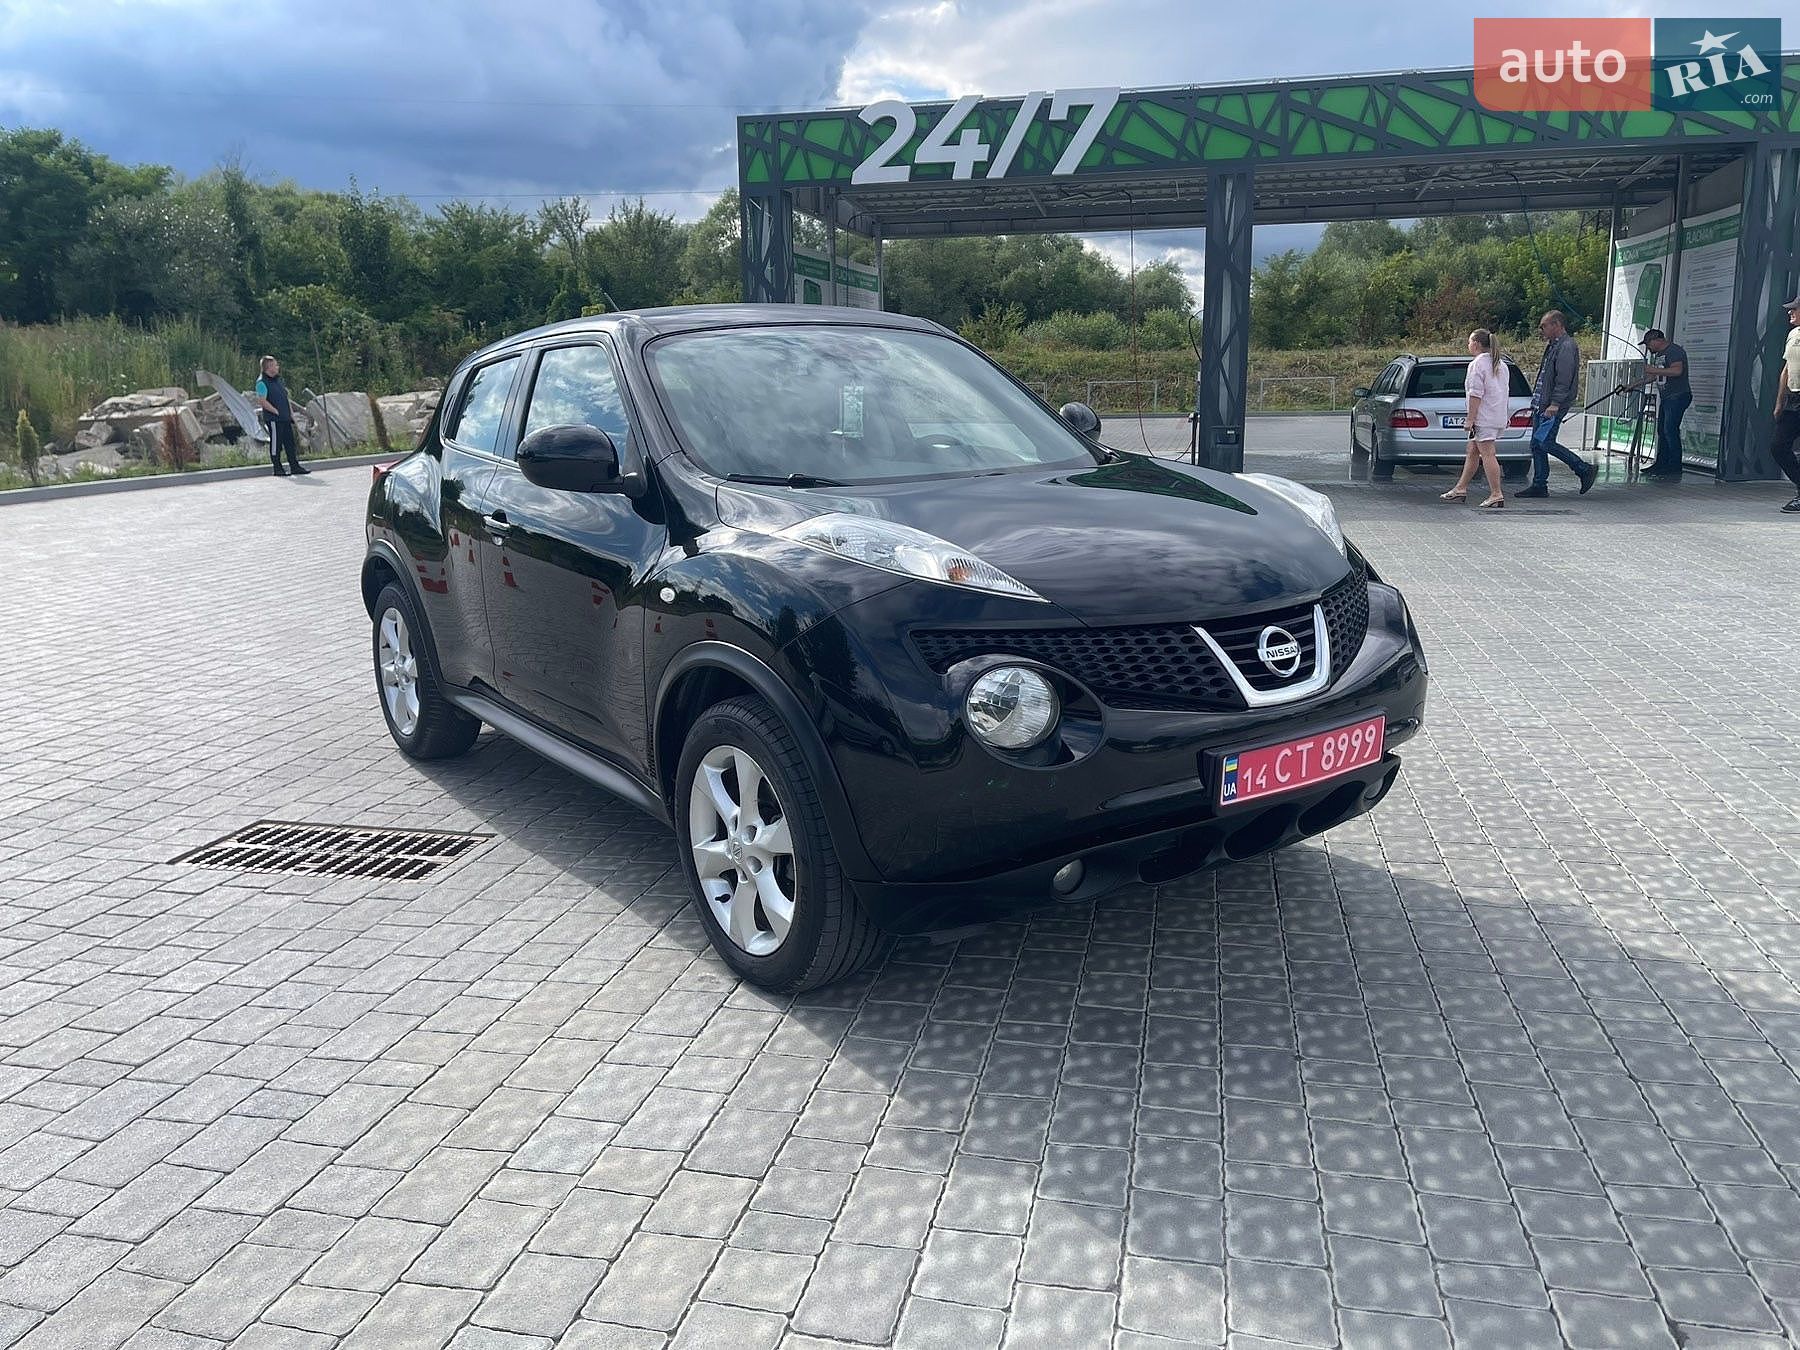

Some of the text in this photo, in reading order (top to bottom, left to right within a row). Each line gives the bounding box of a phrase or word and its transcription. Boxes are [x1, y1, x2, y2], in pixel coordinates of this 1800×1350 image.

[851, 86, 1120, 185] 24/7
[1223, 783, 1237, 796] UA
[1243, 724, 1377, 793] 14 CT 8999
